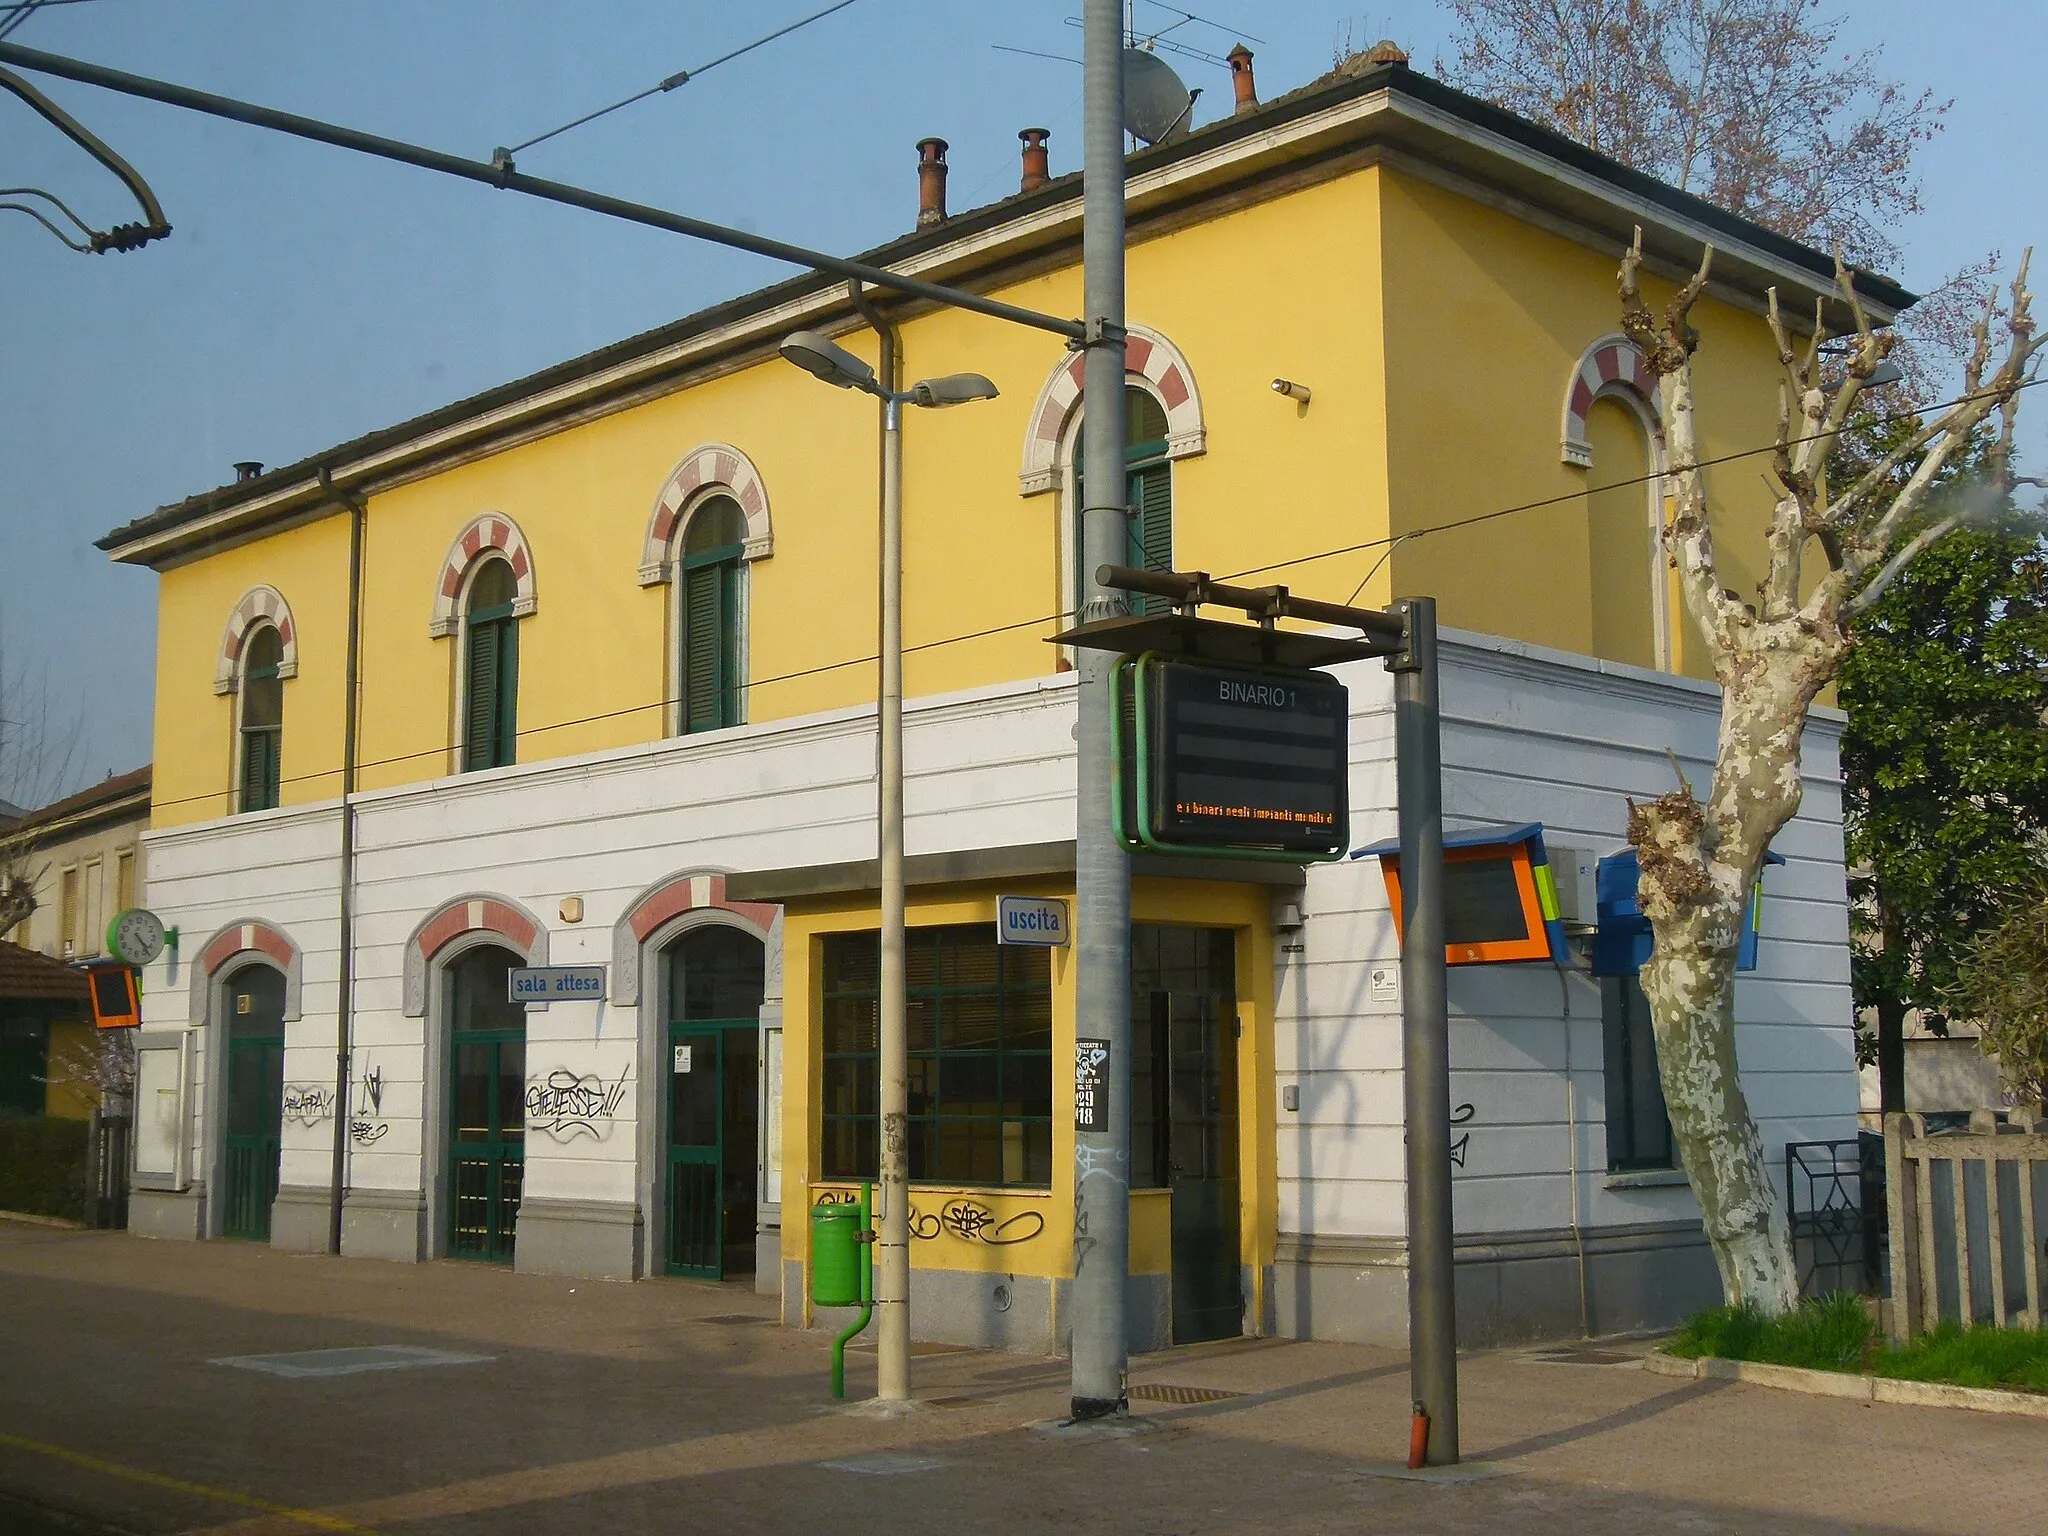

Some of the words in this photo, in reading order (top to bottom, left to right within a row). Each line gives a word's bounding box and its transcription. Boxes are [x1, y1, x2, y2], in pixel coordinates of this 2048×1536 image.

[1219, 680, 1285, 707] BINARIO
[1289, 691, 1296, 708] 1
[1176, 803, 1183, 814] e
[1192, 802, 1223, 816] binari
[1008, 907, 1060, 931] uscita
[516, 974, 547, 992] sala
[556, 974, 600, 991] attesa
